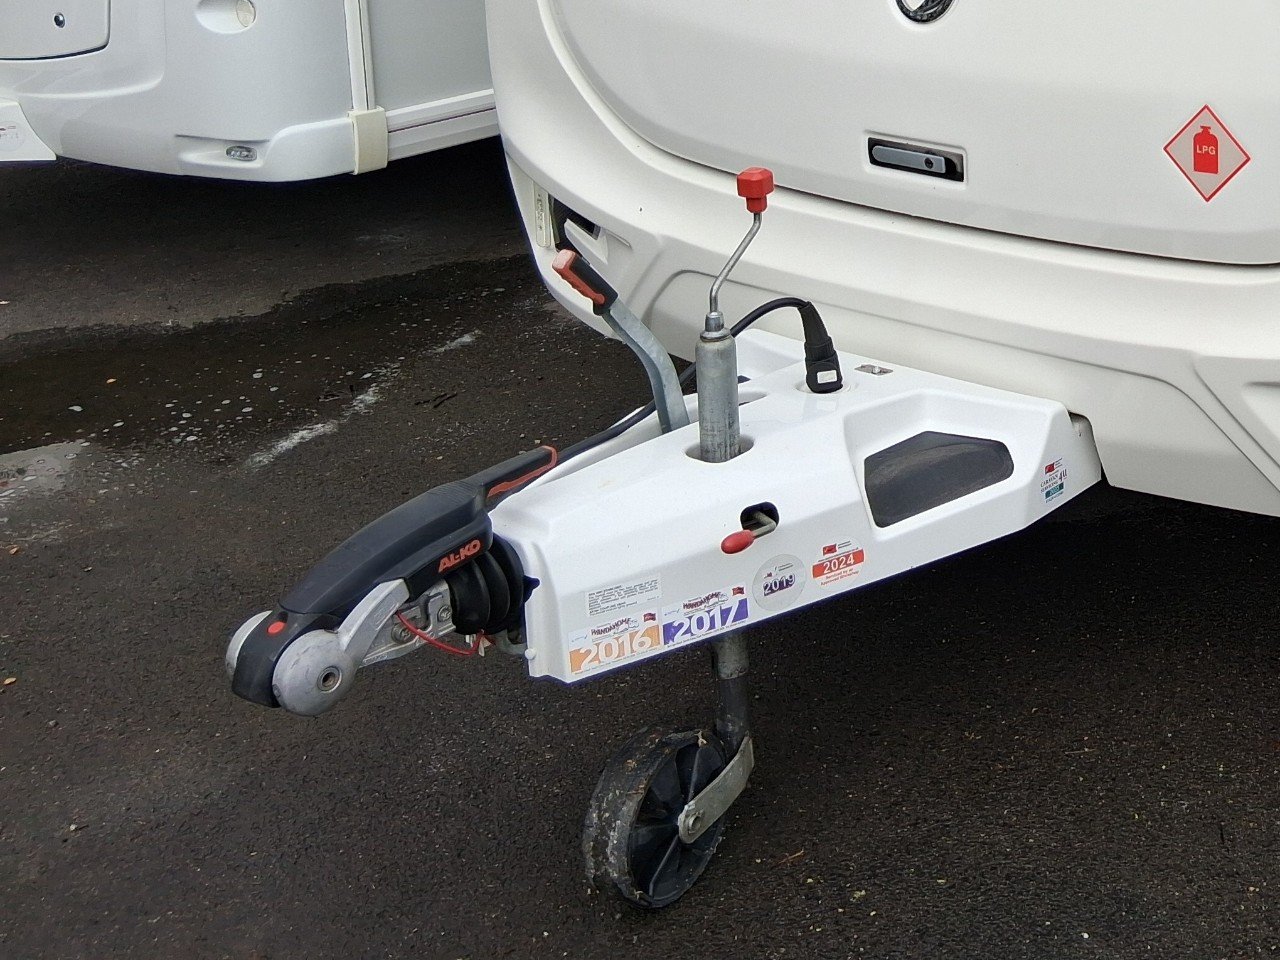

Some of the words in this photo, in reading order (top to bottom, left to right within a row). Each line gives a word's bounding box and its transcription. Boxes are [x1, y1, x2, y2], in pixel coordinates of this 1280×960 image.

[1196, 144, 1217, 156] LPG
[438, 539, 481, 573] AL-KO
[823, 553, 855, 574] 2024
[762, 573, 796, 594] 2019
[672, 599, 740, 644] 2017
[579, 624, 653, 672] 2016
